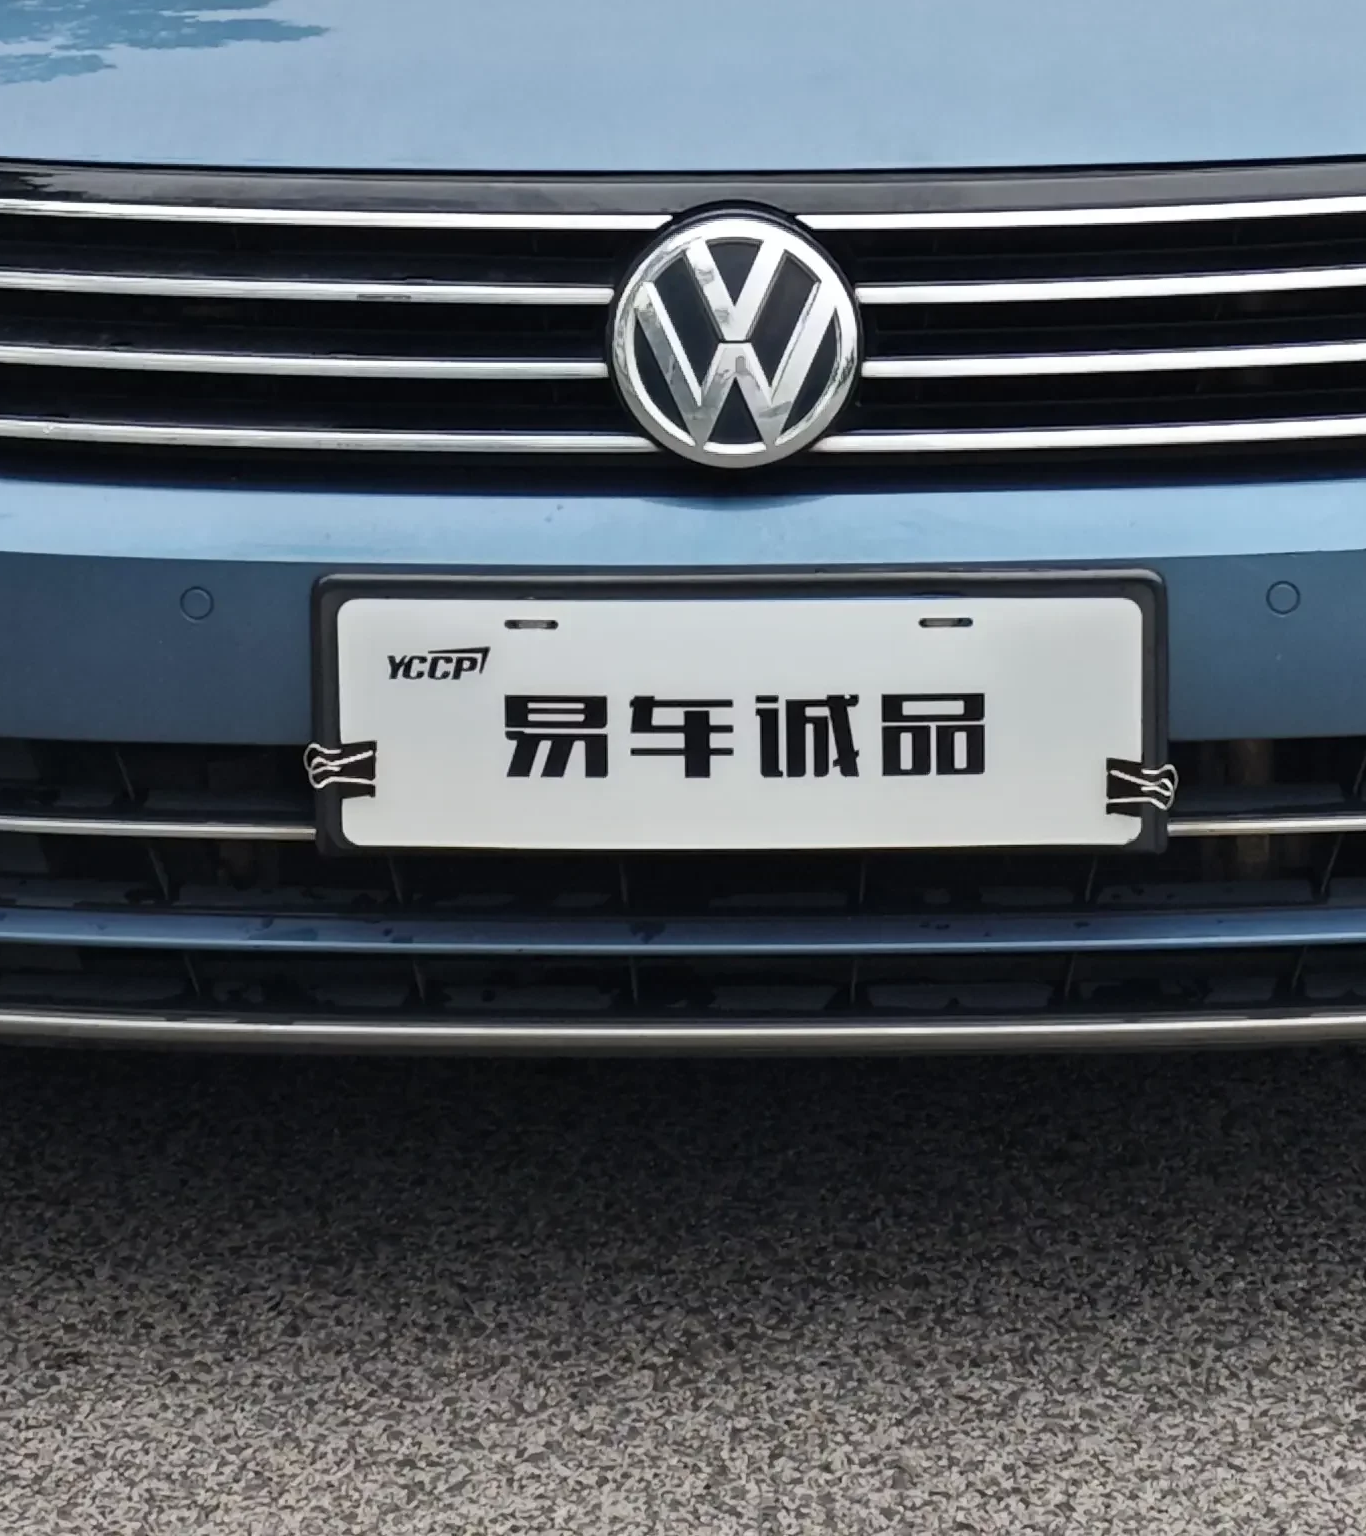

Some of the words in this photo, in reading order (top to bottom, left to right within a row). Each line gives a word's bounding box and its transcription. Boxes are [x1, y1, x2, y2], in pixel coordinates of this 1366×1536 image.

[387, 647, 490, 680] YCCP
[504, 693, 986, 779] 易车诚品
